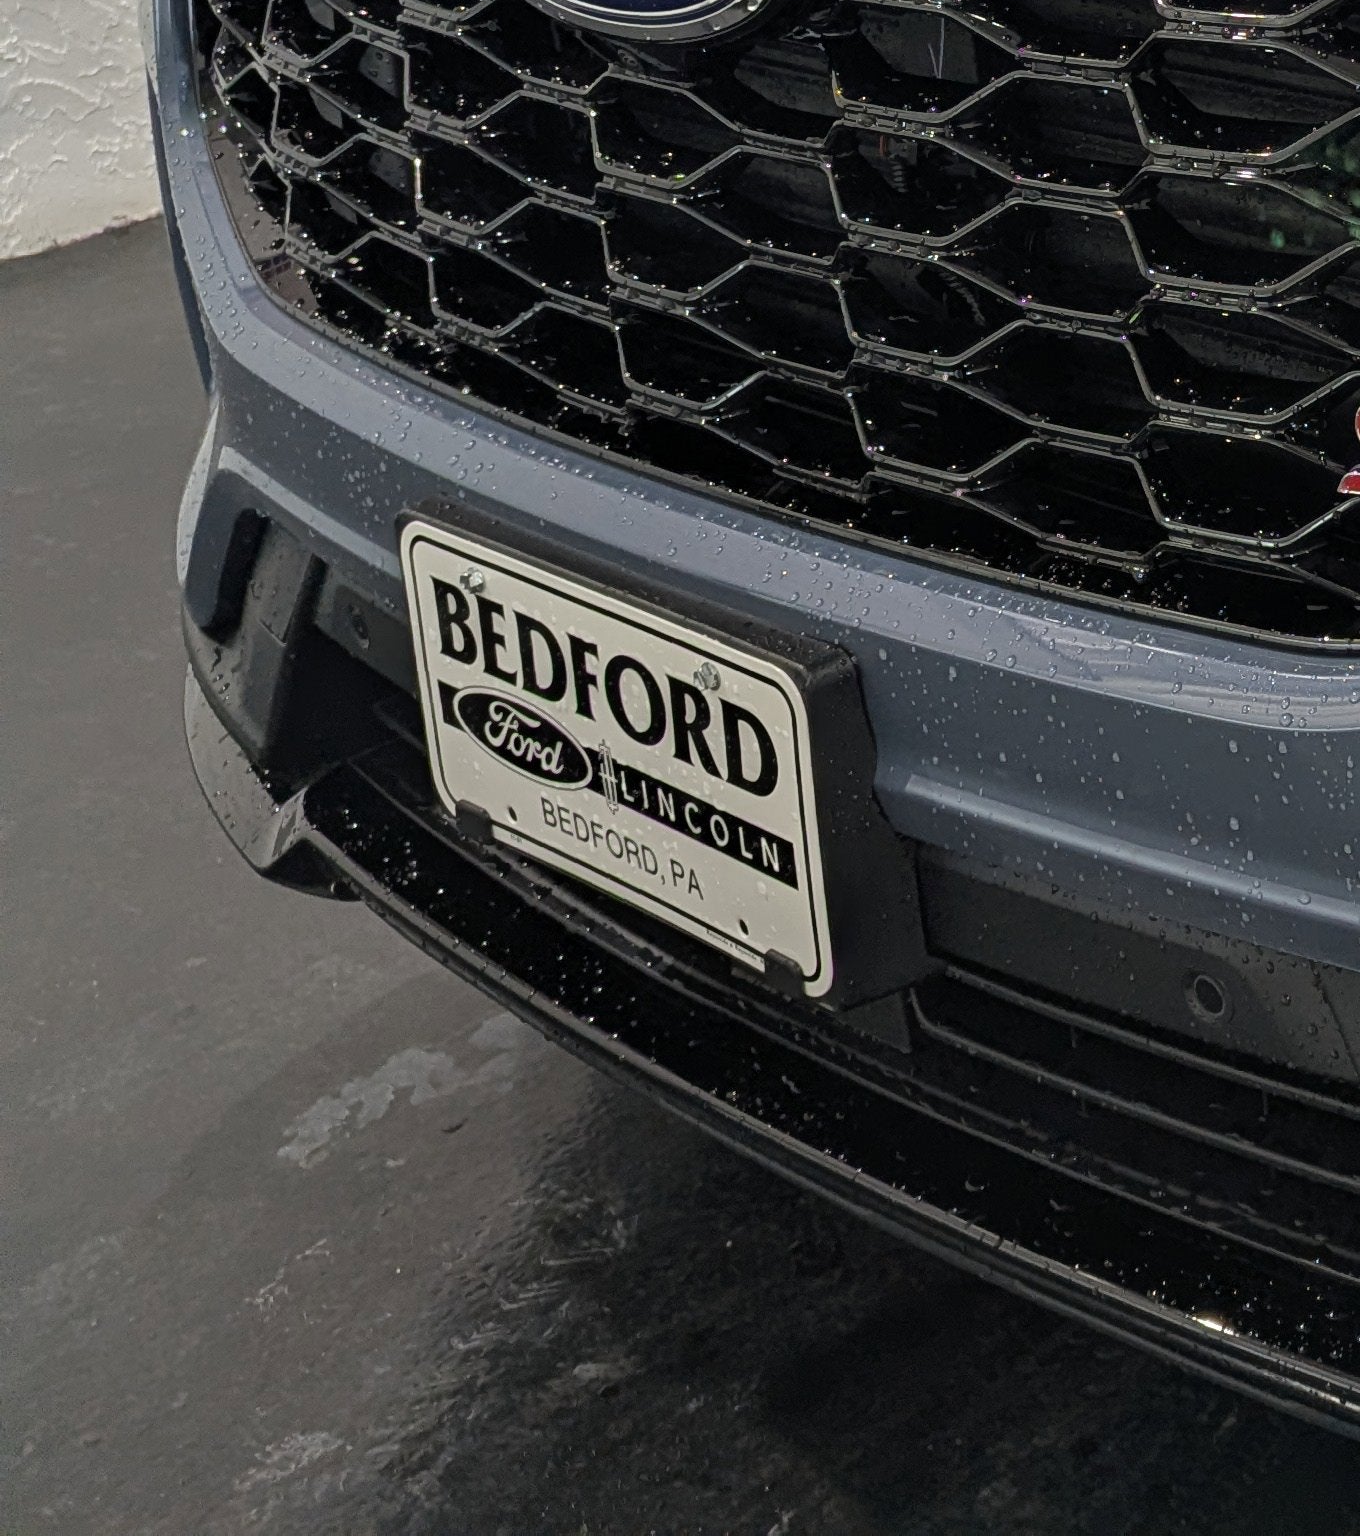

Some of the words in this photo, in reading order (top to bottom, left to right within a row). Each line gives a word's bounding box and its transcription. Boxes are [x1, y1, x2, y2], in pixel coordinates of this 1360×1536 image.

[429, 575, 780, 797] BEDFORD
[483, 702, 566, 775] Ford
[541, 796, 667, 887] BEDFORD,
[672, 857, 705, 901] PA
[619, 770, 783, 873] LINCOLN
